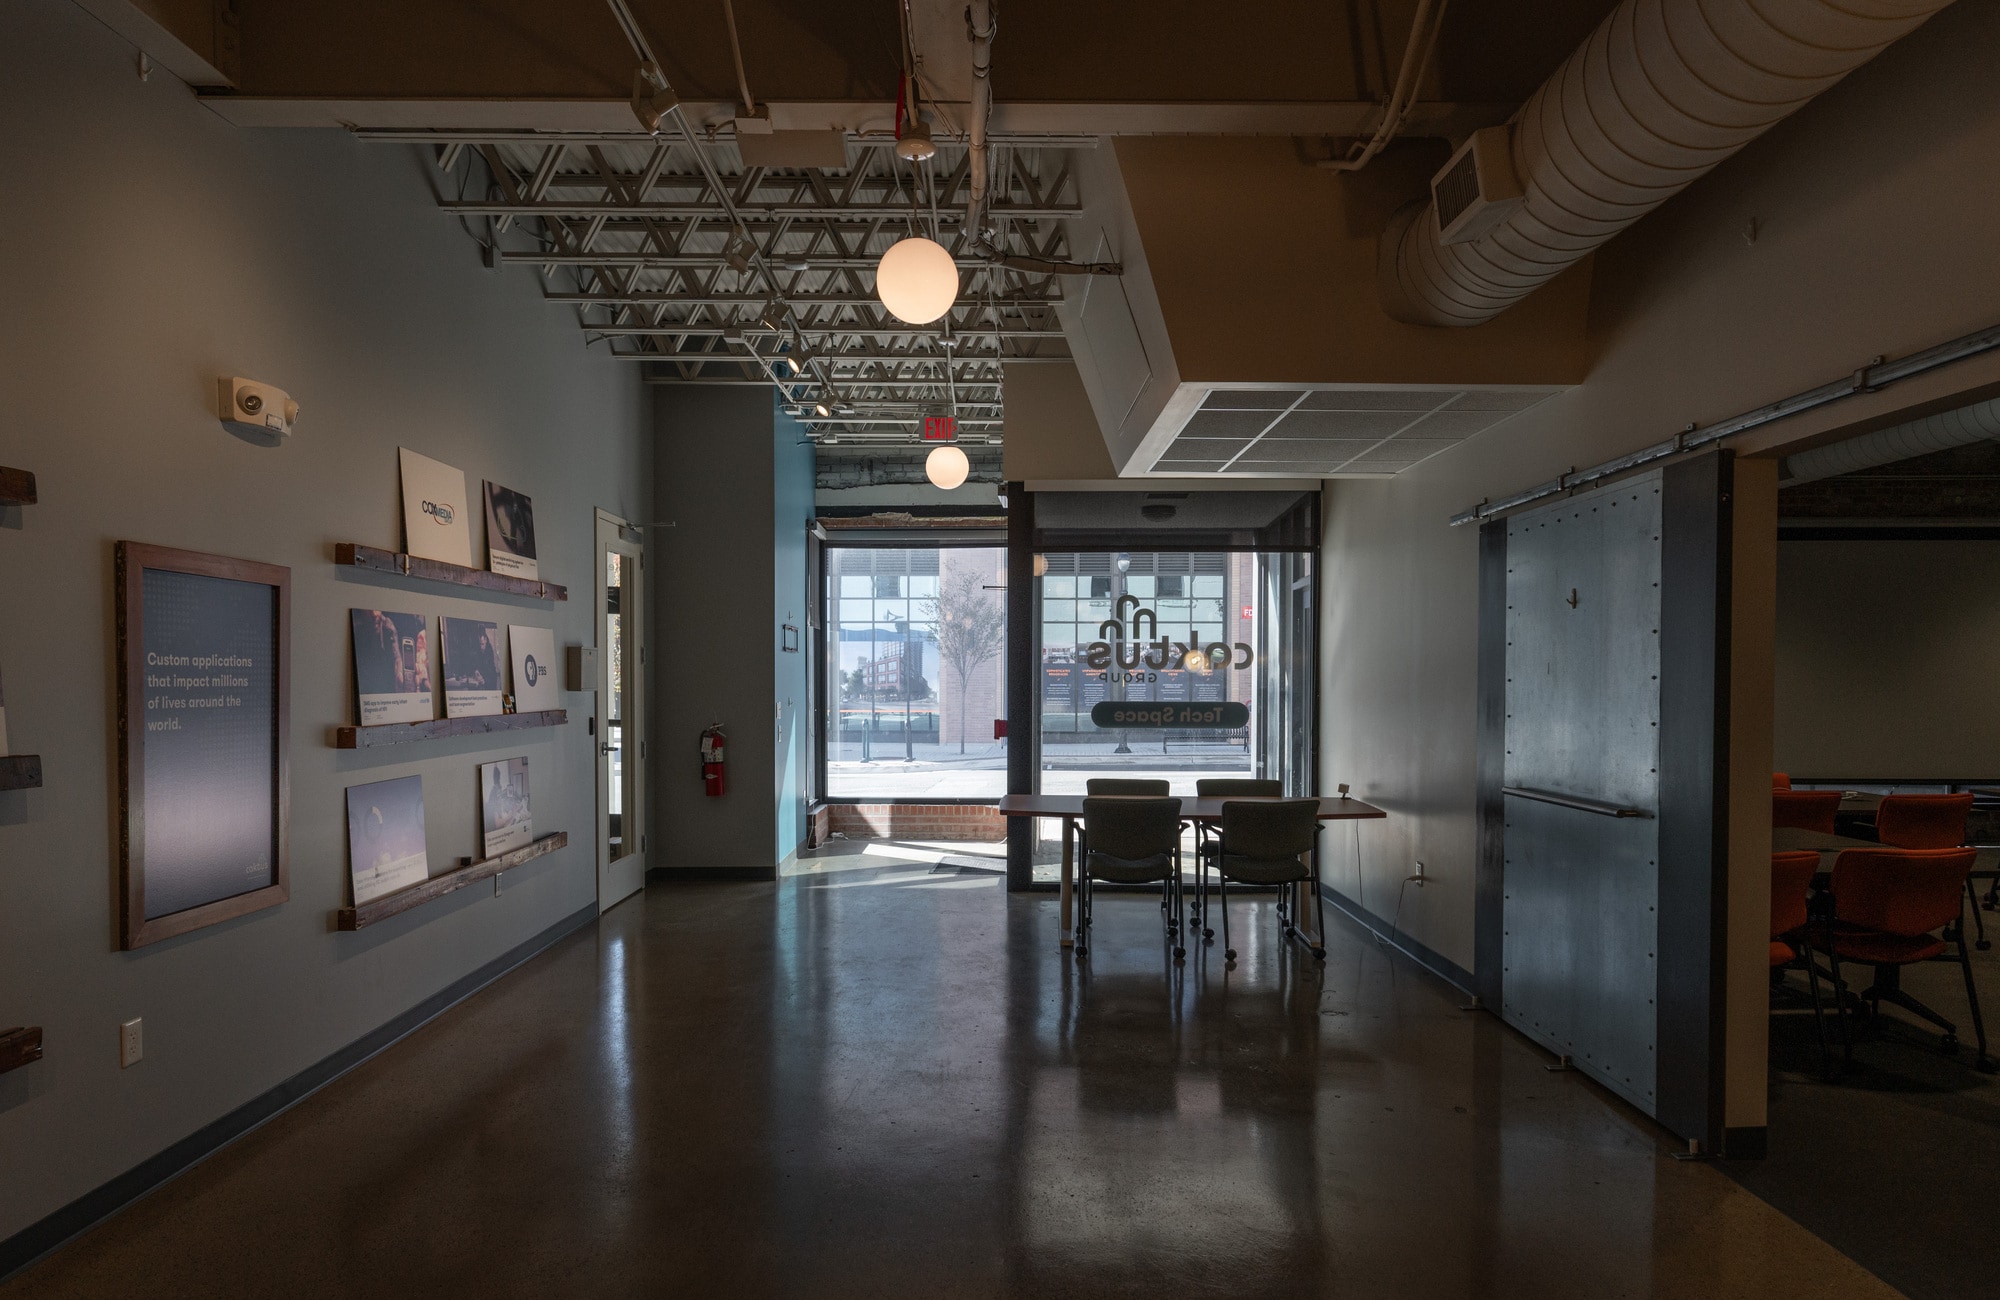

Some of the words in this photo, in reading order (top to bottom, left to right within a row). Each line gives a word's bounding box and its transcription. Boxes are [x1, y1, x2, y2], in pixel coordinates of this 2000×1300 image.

[925, 417, 954, 440] EXIT
[147, 652, 190, 666] Custom
[192, 653, 253, 670] applications
[147, 674, 171, 687] that
[173, 674, 210, 690] impact
[211, 674, 249, 687] millions
[147, 696, 159, 709] of
[162, 696, 186, 709] lives
[188, 695, 224, 708] around
[226, 695, 241, 707] the
[147, 717, 182, 731] world.
